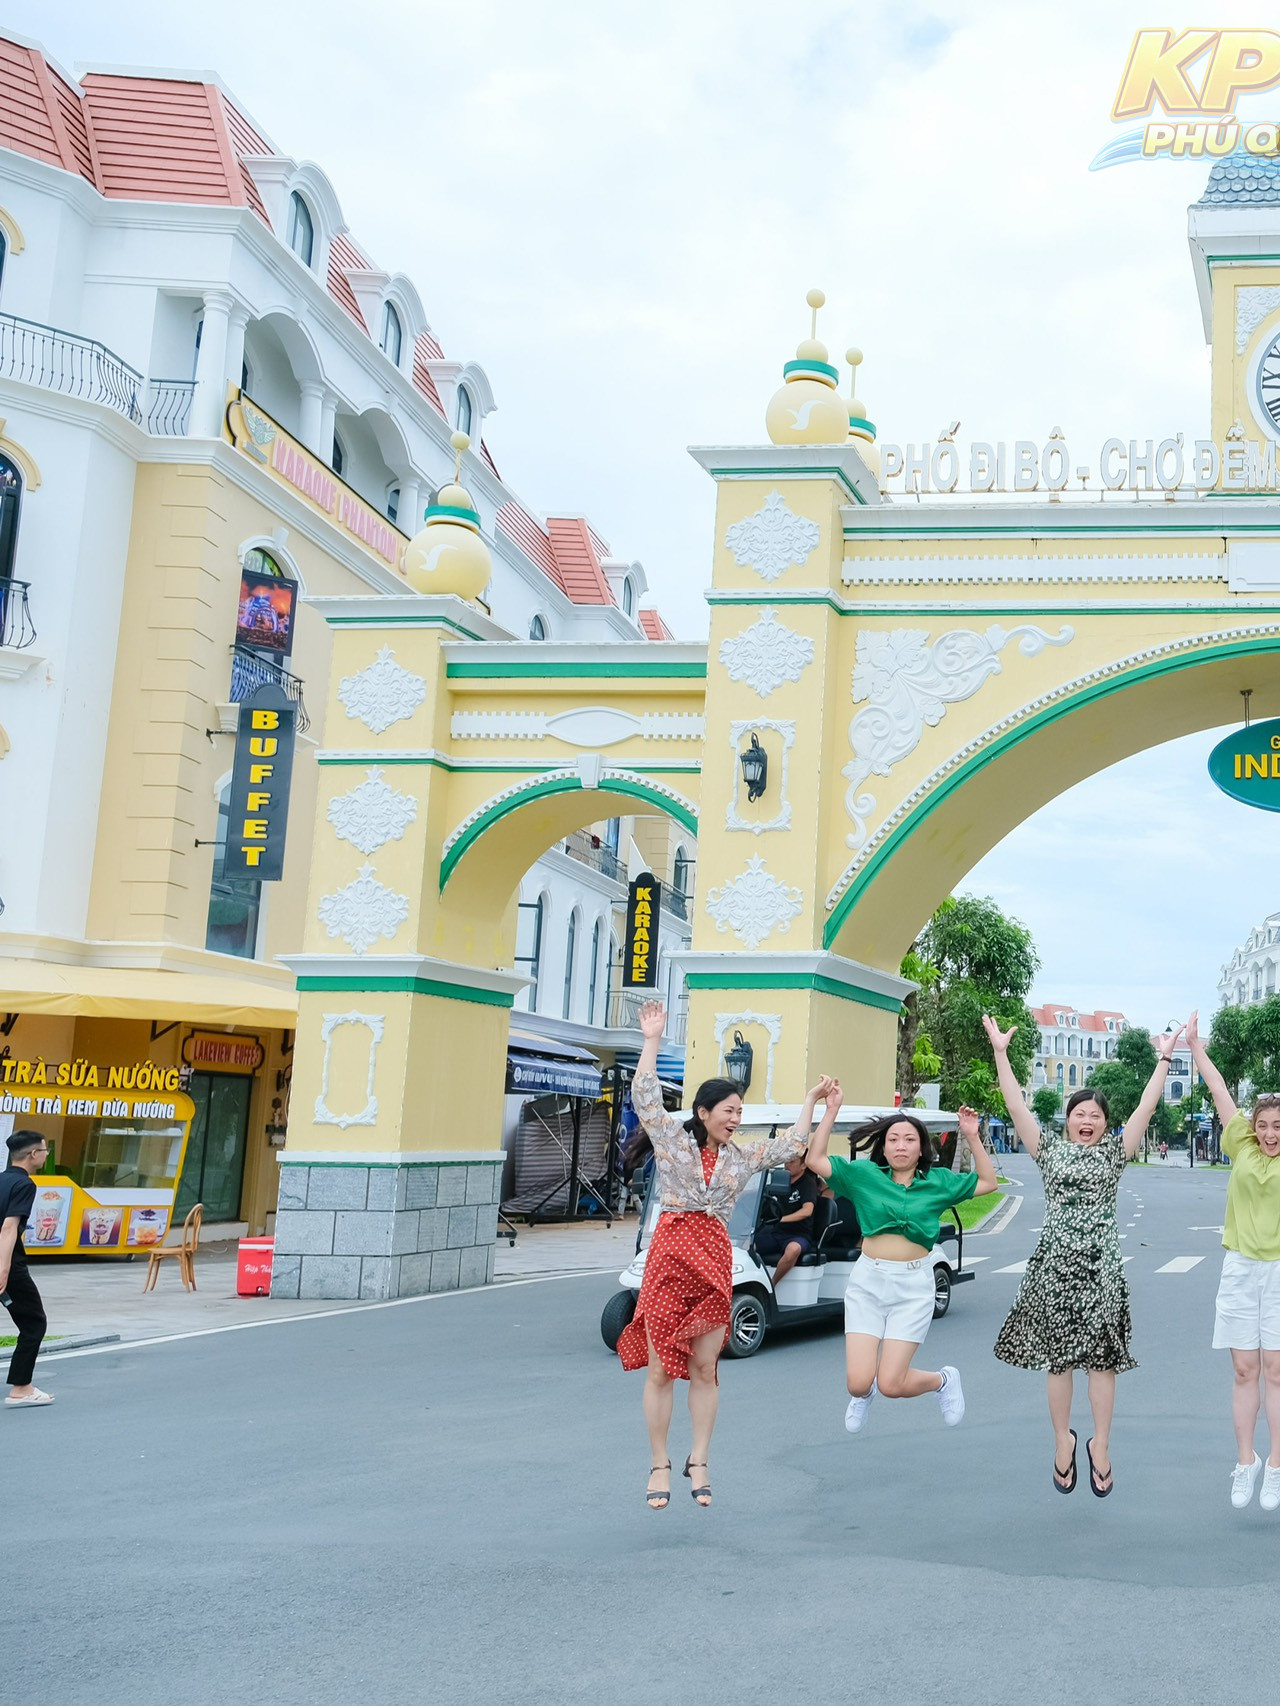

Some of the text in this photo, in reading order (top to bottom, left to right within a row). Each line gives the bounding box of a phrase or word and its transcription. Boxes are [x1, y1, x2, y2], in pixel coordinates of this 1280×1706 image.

[880, 421, 961, 493] PHỐ
[969, 441, 1006, 493] ĐI
[272, 437, 398, 564] KARAOKE PHANTOM
[241, 709, 280, 867] BUFFET
[631, 887, 652, 983] KARAOKE
[2, 1056, 179, 1092] TRÀ SỮA NƯỚNG
[36, 1095, 62, 1114] TRÀ
[67, 1099, 98, 1116] KEM
[102, 1098, 128, 1117] DỪA
[133, 1099, 175, 1119] NƯỚNG
